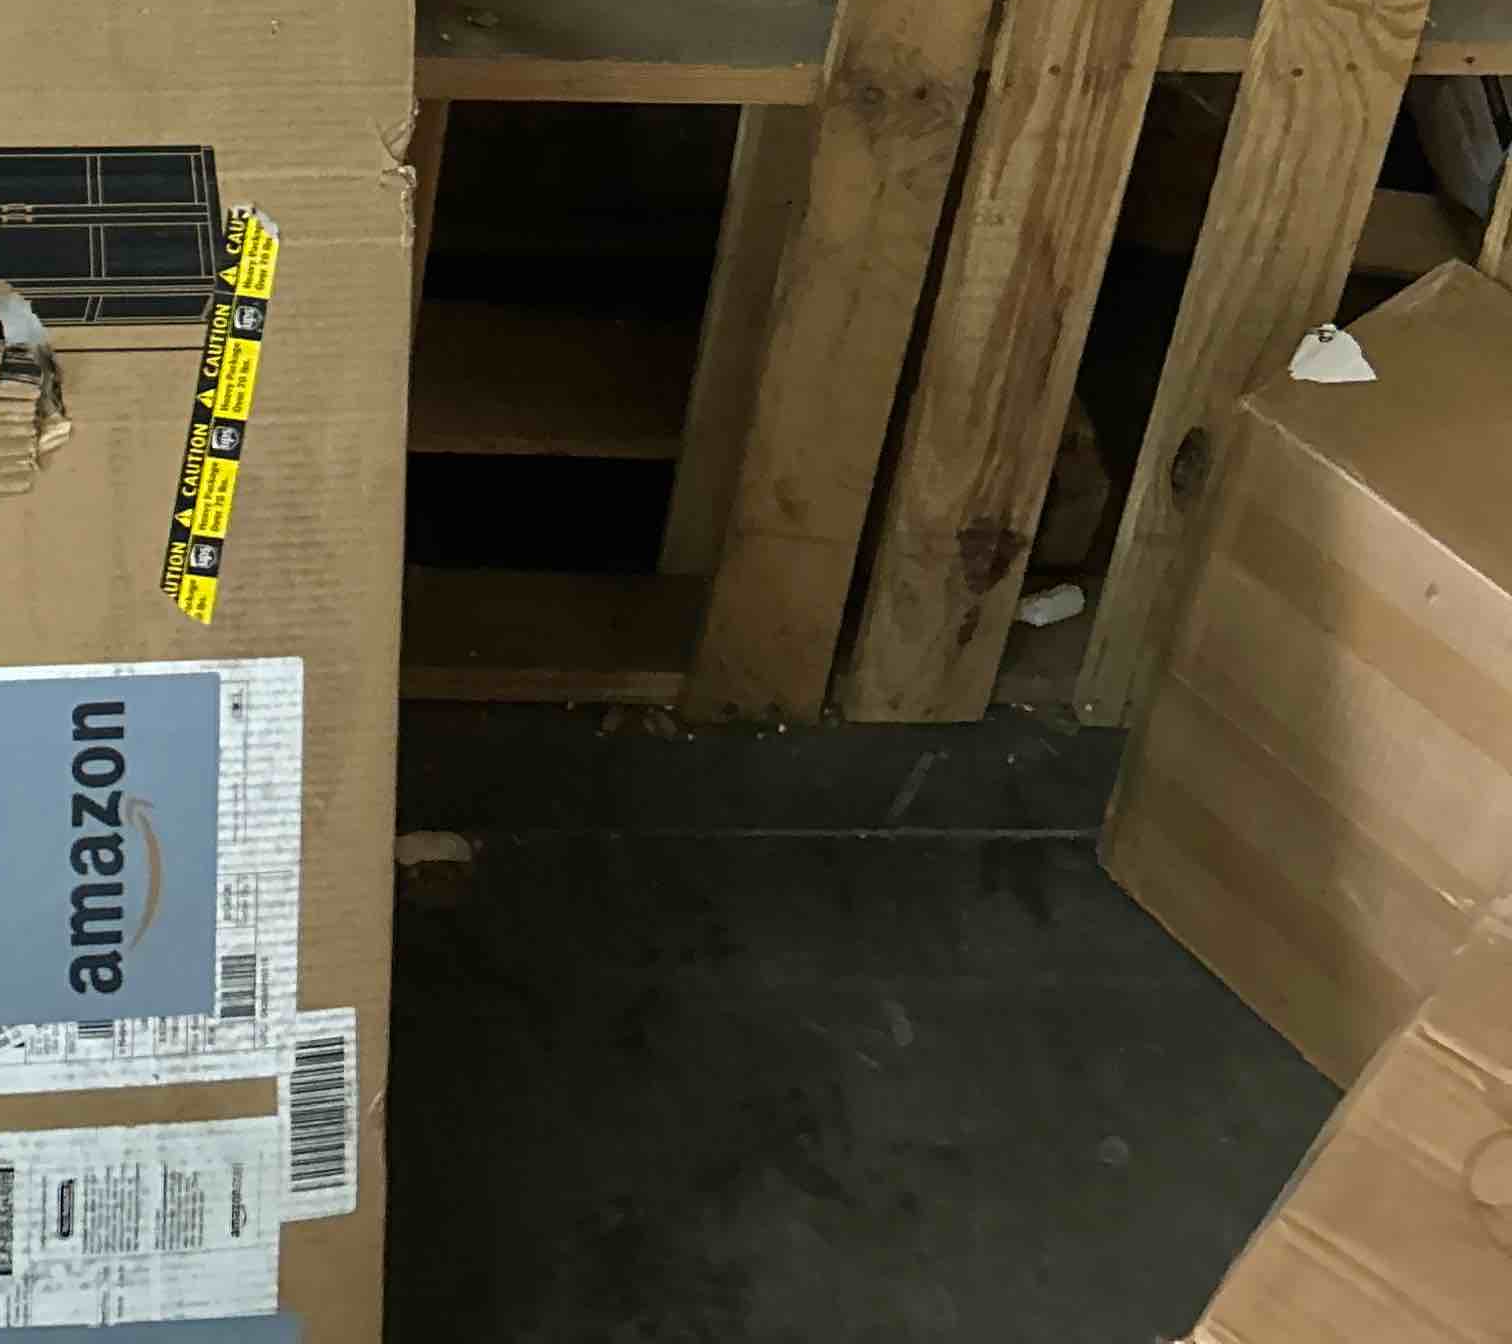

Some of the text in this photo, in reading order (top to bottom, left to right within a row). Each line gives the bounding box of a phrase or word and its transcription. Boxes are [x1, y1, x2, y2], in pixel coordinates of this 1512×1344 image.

[203, 303, 231, 378] CAUTION
[220, 342, 241, 411] Heavy Package
[182, 423, 209, 497] CAUTION
[69, 699, 126, 997] amazon
